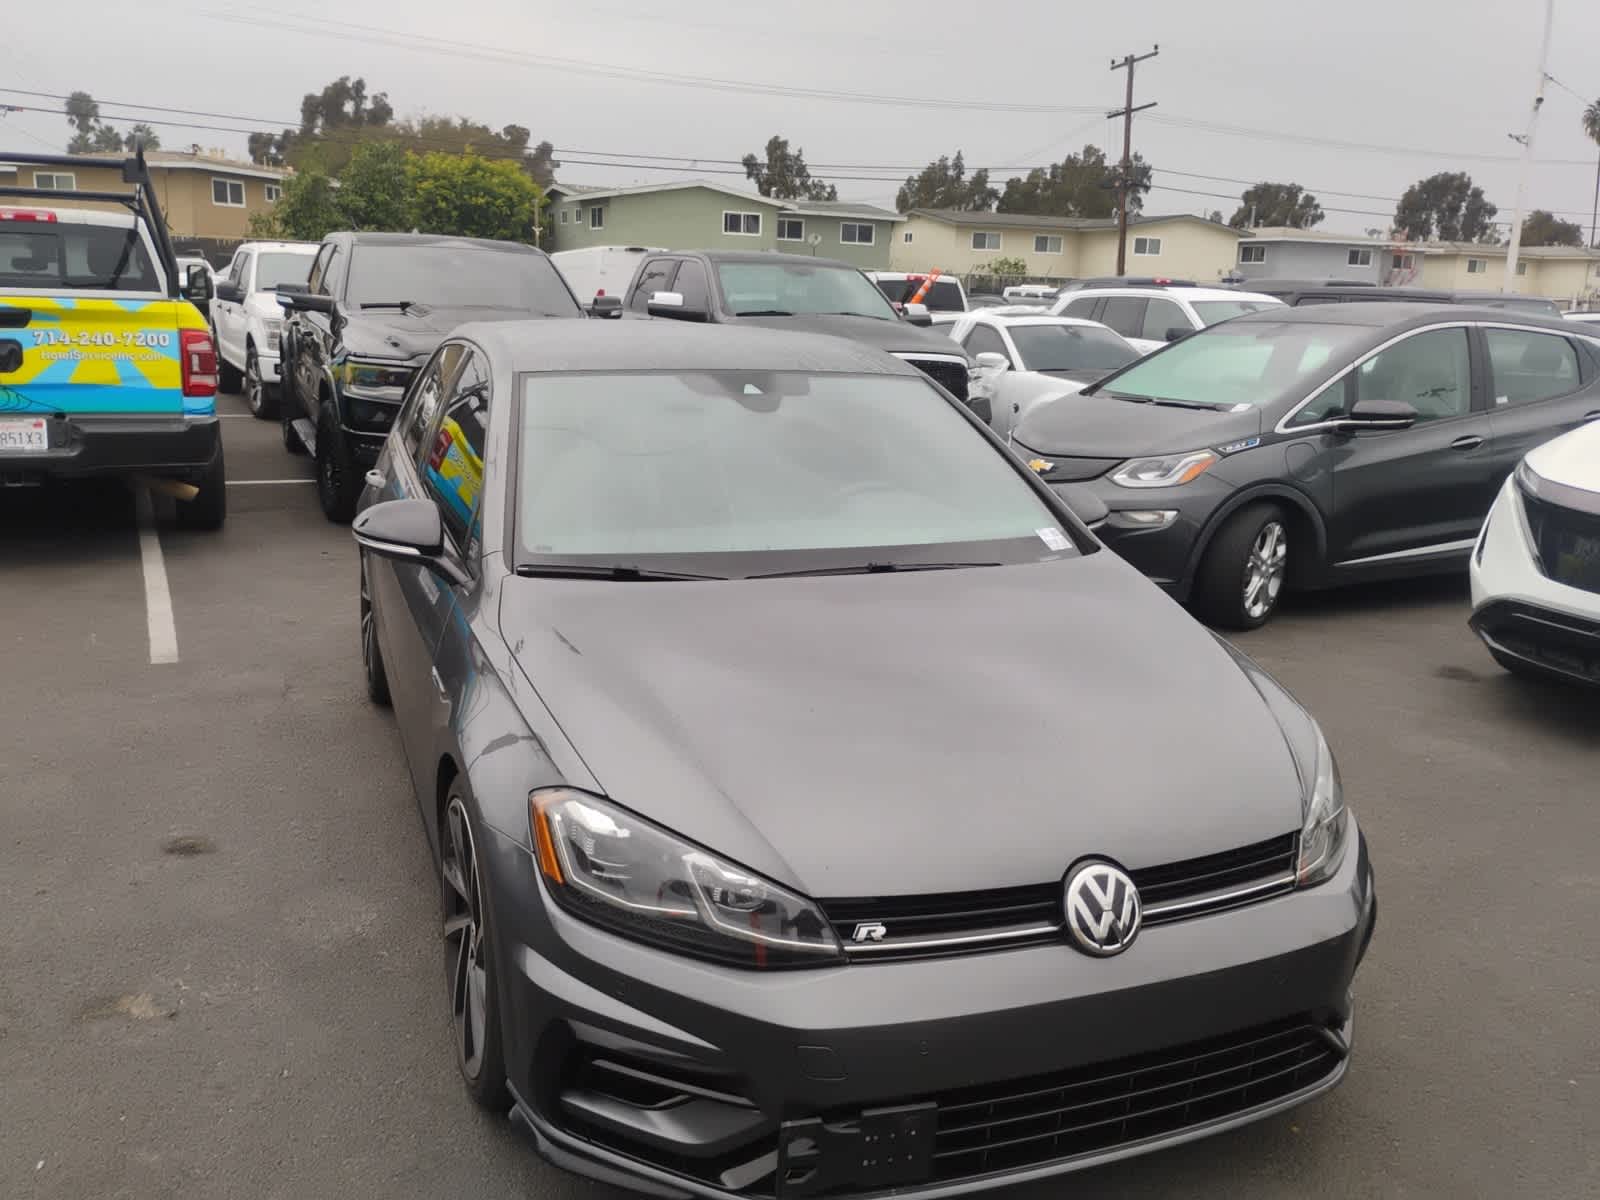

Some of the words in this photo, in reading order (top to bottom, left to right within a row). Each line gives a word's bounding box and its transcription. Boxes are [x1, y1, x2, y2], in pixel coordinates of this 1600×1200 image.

[33, 330, 170, 347] 714-240-7200
[1066, 863, 1142, 951] VW
[852, 922, 887, 942] R
